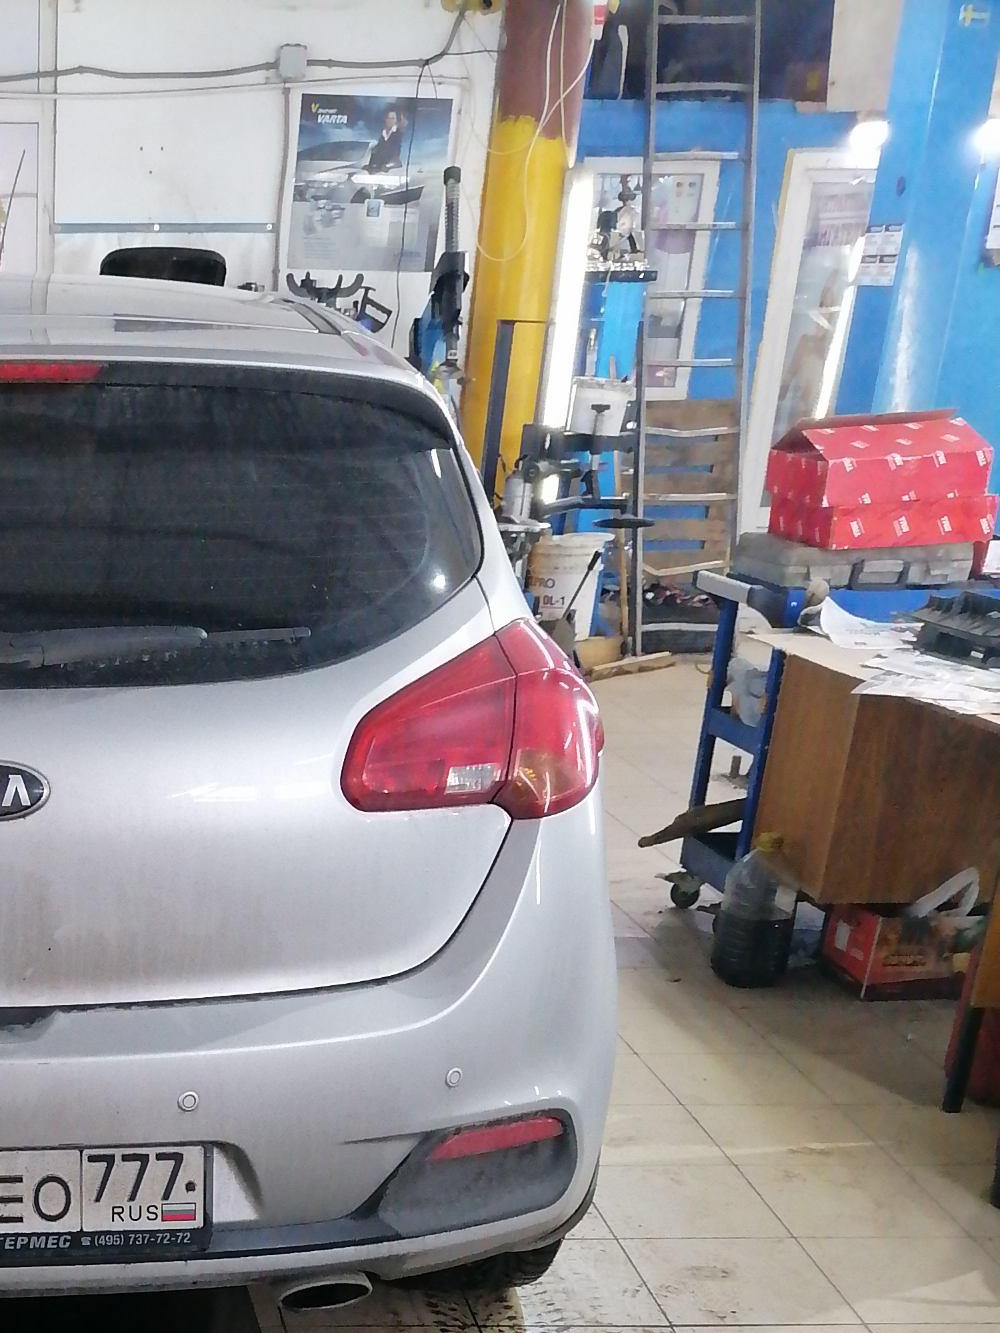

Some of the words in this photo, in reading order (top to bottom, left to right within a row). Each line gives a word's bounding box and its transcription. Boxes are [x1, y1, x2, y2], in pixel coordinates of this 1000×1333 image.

[317, 114, 348, 124] VARTA
[86, 1151, 185, 1203] 777
[111, 1204, 159, 1223] RUS
[94, 1233, 125, 1247] (495)
[127, 1231, 192, 1246] 737-72-72
